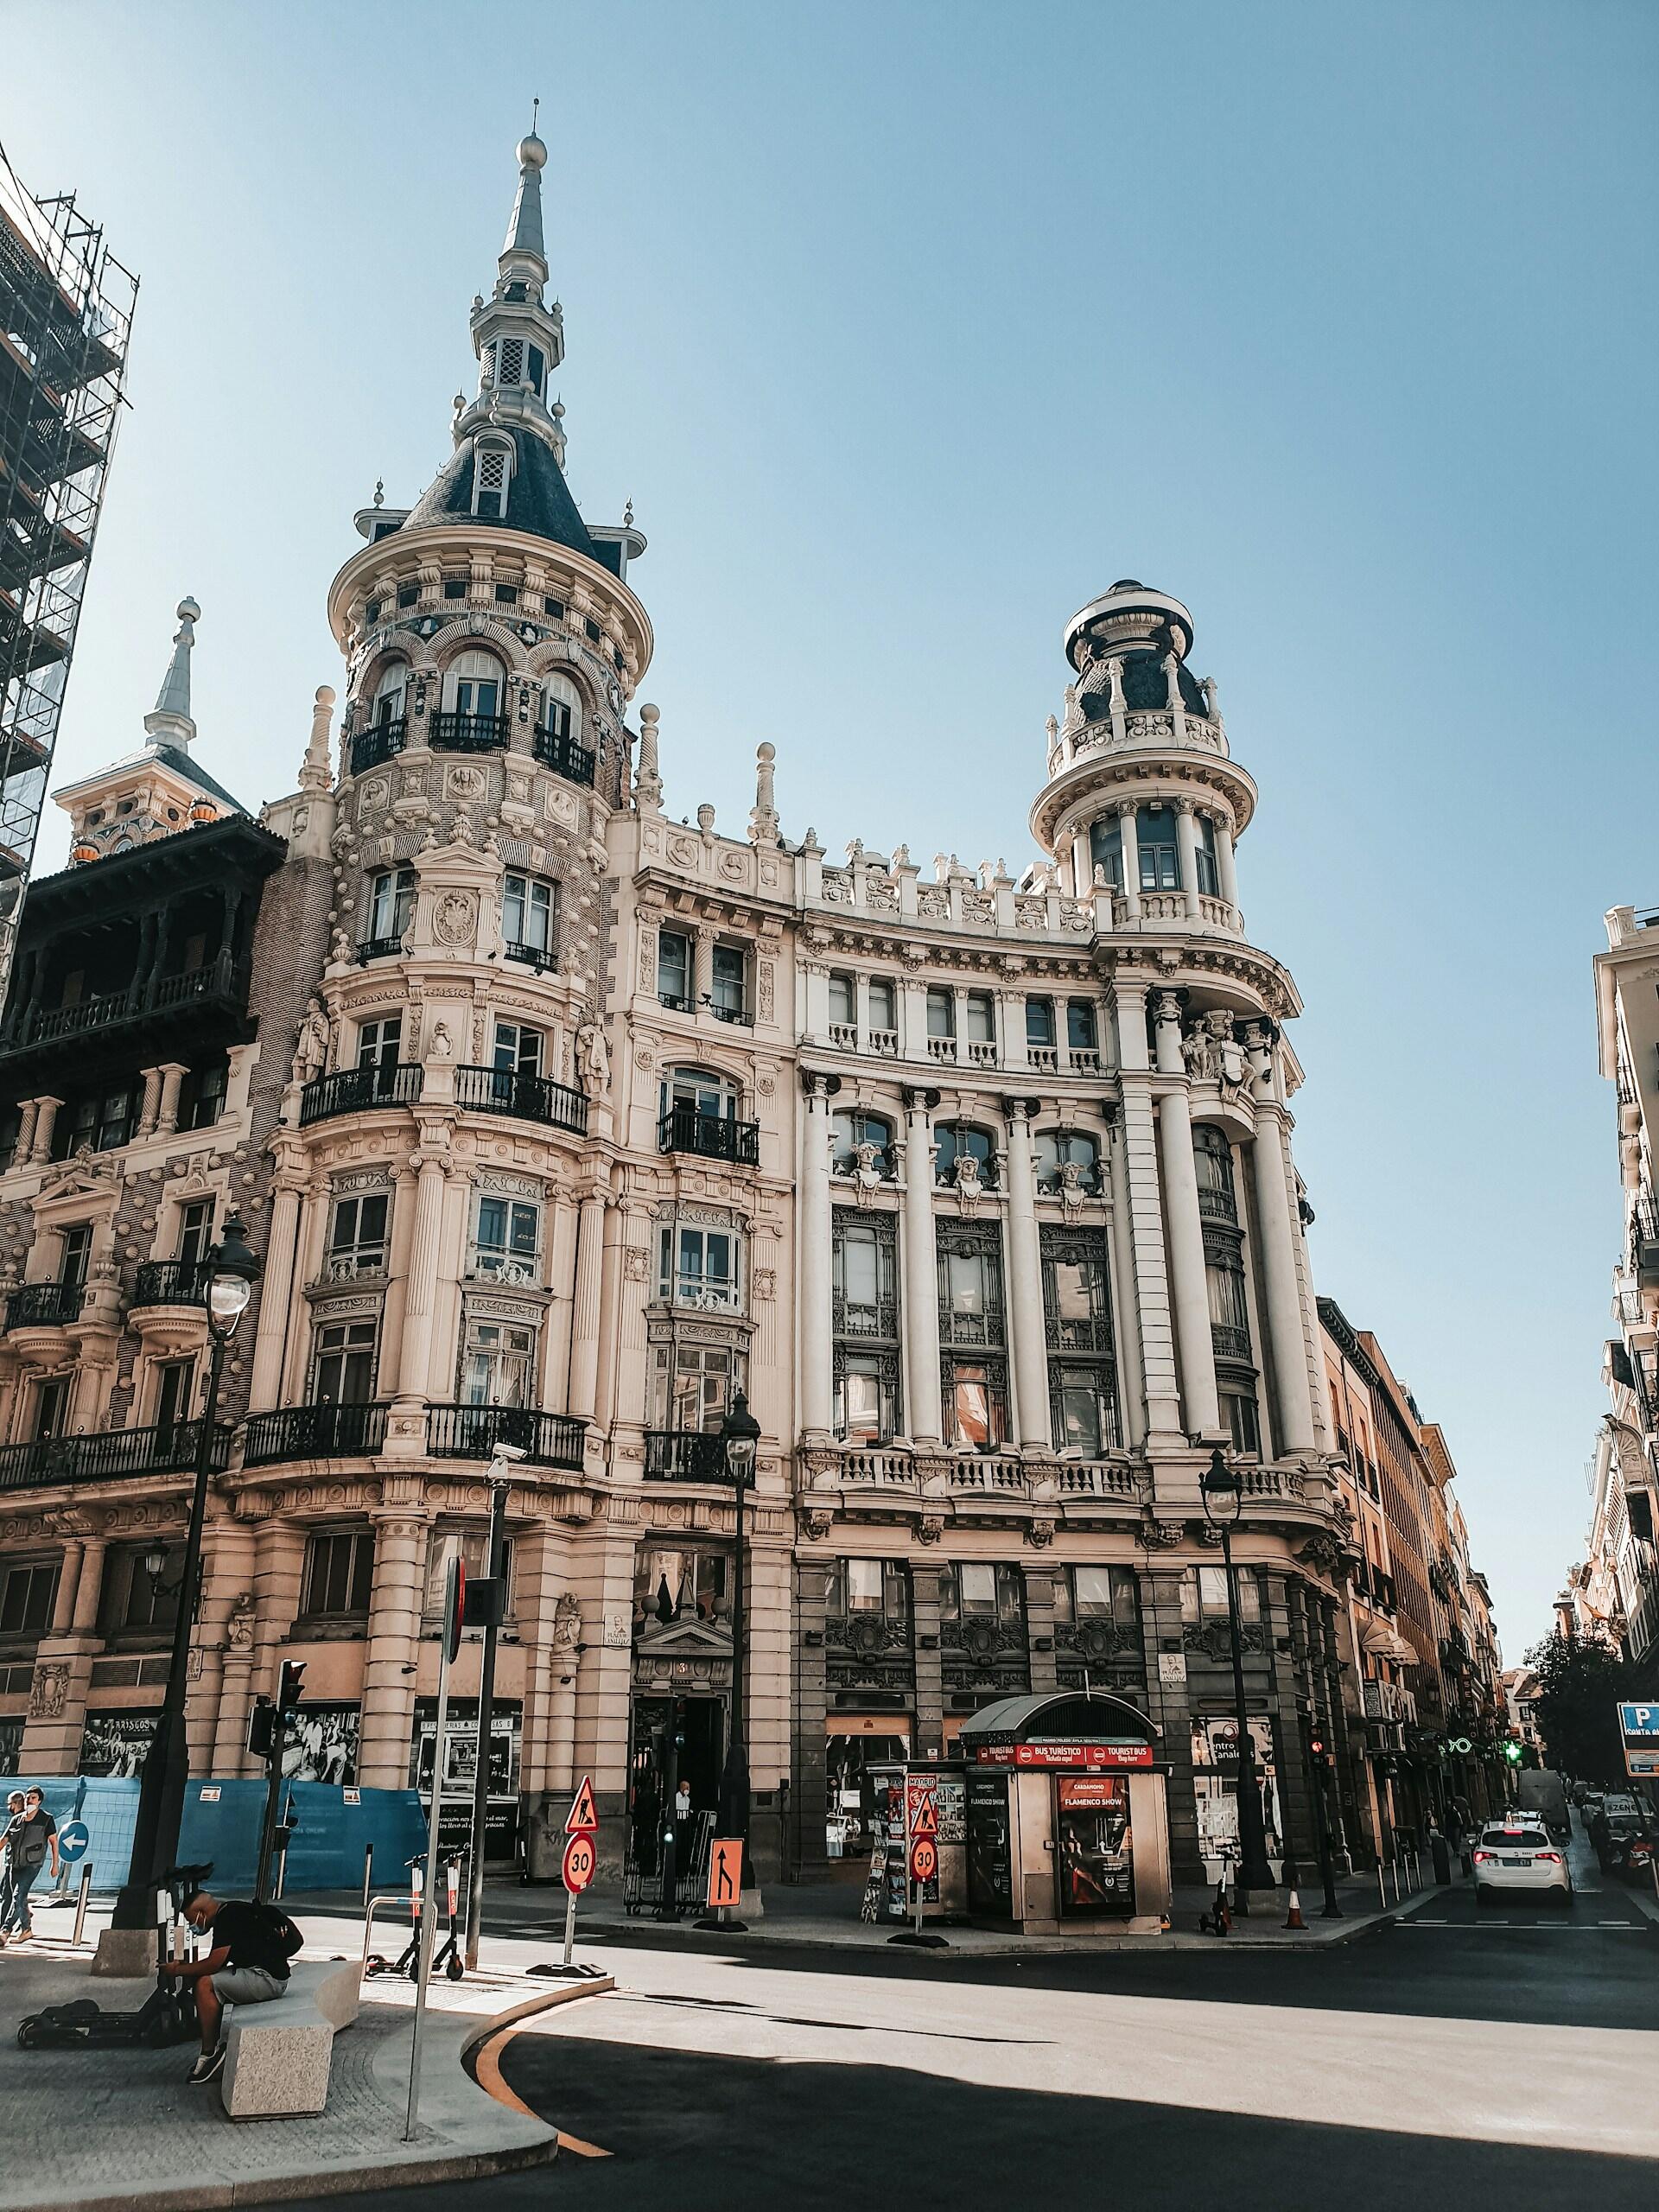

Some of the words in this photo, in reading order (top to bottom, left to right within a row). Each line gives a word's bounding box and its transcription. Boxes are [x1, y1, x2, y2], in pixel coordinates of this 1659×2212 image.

[679, 1662, 685, 1673] 3
[1635, 1707, 1650, 1726] P
[1005, 1745, 1014, 1754] BUS
[1049, 1745, 1081, 1756] TURÍSTICO
[1108, 1747, 1134, 1756] TOURIST
[1134, 1747, 1147, 1756] BUS
[909, 1777, 935, 1787] MADRID
[571, 1853, 589, 1872] 30
[917, 1852, 932, 1867] 30
